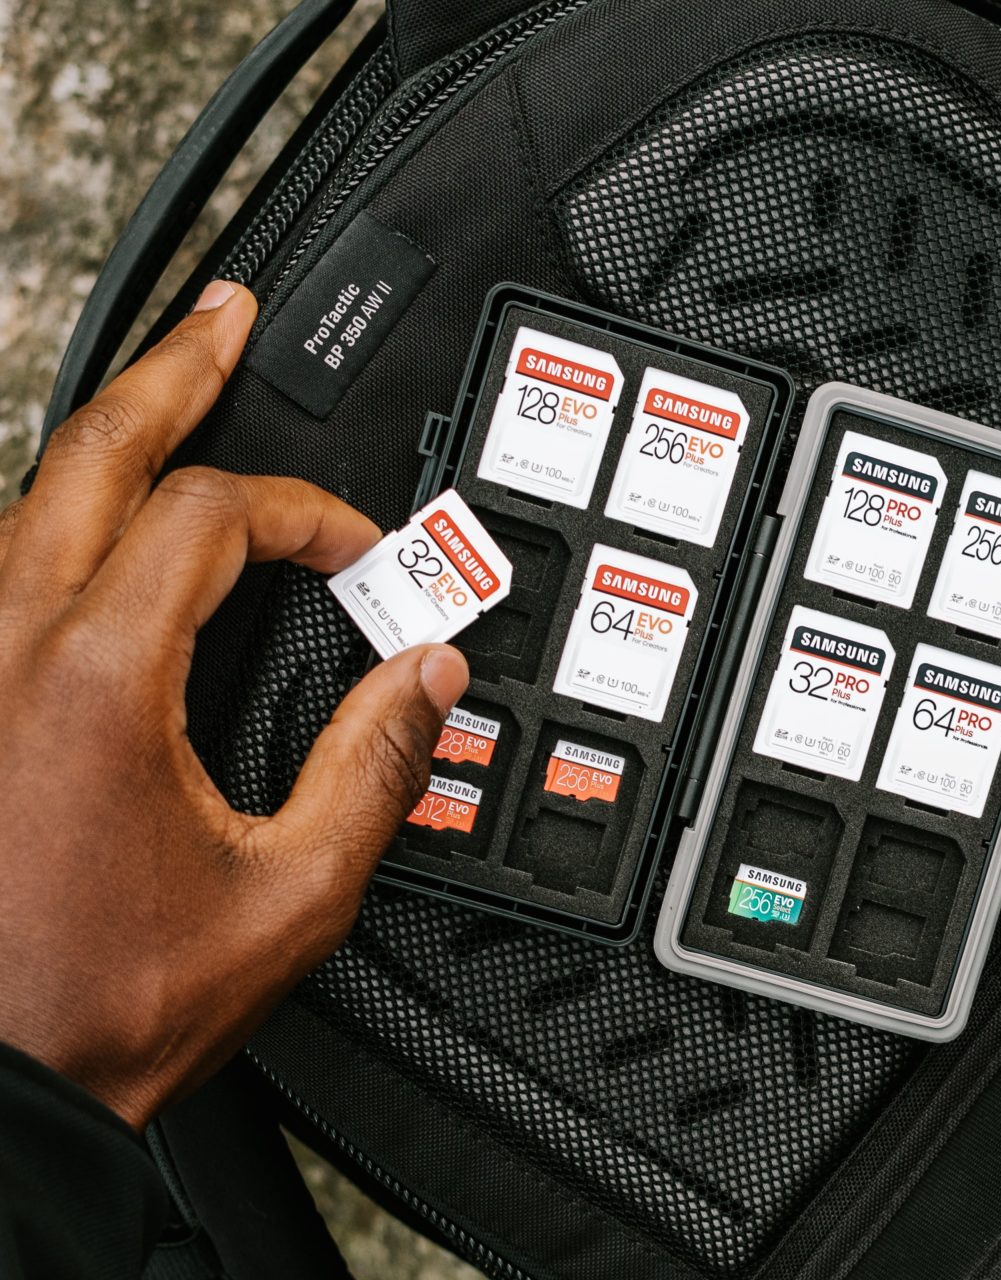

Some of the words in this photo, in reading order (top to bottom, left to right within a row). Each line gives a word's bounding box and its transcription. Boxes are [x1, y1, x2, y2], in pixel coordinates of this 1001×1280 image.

[304, 284, 360, 354] ProTactic
[324, 344, 344, 369] BP
[341, 316, 366, 347] 350
[361, 290, 383, 319] AW
[376, 280, 392, 295] II
[525, 354, 607, 391] SAMSUNG
[517, 384, 559, 424] 128
[561, 396, 598, 419] EVO
[652, 394, 732, 430] SAMSUNG
[558, 412, 578, 426] Plus
[640, 423, 688, 464] 256
[688, 436, 724, 458] EVO
[684, 452, 705, 465] Plus
[545, 466, 562, 480] 100
[852, 458, 931, 493] SAMSUNG
[672, 506, 689, 518] 100
[844, 487, 885, 527] 128
[886, 499, 921, 521] PRO
[883, 514, 902, 528] Plus
[434, 518, 494, 591] SAMSUNG
[398, 539, 443, 589] 32
[437, 572, 467, 606] EVO
[869, 568, 884, 580] 100
[888, 572, 901, 584] 90
[429, 583, 444, 602] Plus
[602, 571, 682, 606] SAMSUNG
[388, 618, 402, 636] 100
[590, 601, 634, 640] 64
[636, 612, 672, 634] EVO
[634, 628, 654, 641] Plus
[801, 632, 880, 666] SAMSUNG
[621, 682, 637, 694] 100
[789, 661, 833, 701] 32
[835, 672, 870, 694] PRO
[924, 670, 1001, 704] SAMSUNG
[832, 688, 851, 700] Plus
[448, 712, 496, 734] AMSUNG
[913, 698, 956, 737] 64
[958, 709, 992, 731] PRO
[437, 730, 464, 755] 28
[466, 736, 487, 750] EVO
[955, 725, 974, 738] Plus
[465, 745, 479, 754] Plus
[565, 746, 620, 769] SAMSUNG
[818, 741, 833, 752] 100
[838, 746, 850, 758] 60
[556, 764, 590, 791] 256
[592, 772, 612, 784] EVO
[591, 781, 604, 789] Plus
[940, 777, 956, 789] 100
[960, 783, 972, 794] 90
[430, 779, 477, 799] AMSUNG
[447, 810, 460, 819] Plus
[449, 802, 469, 814] EVO
[748, 870, 802, 892] SAMSUNG
[739, 887, 772, 914] 256
[774, 895, 794, 908] EVO
[773, 904, 791, 914] Select
